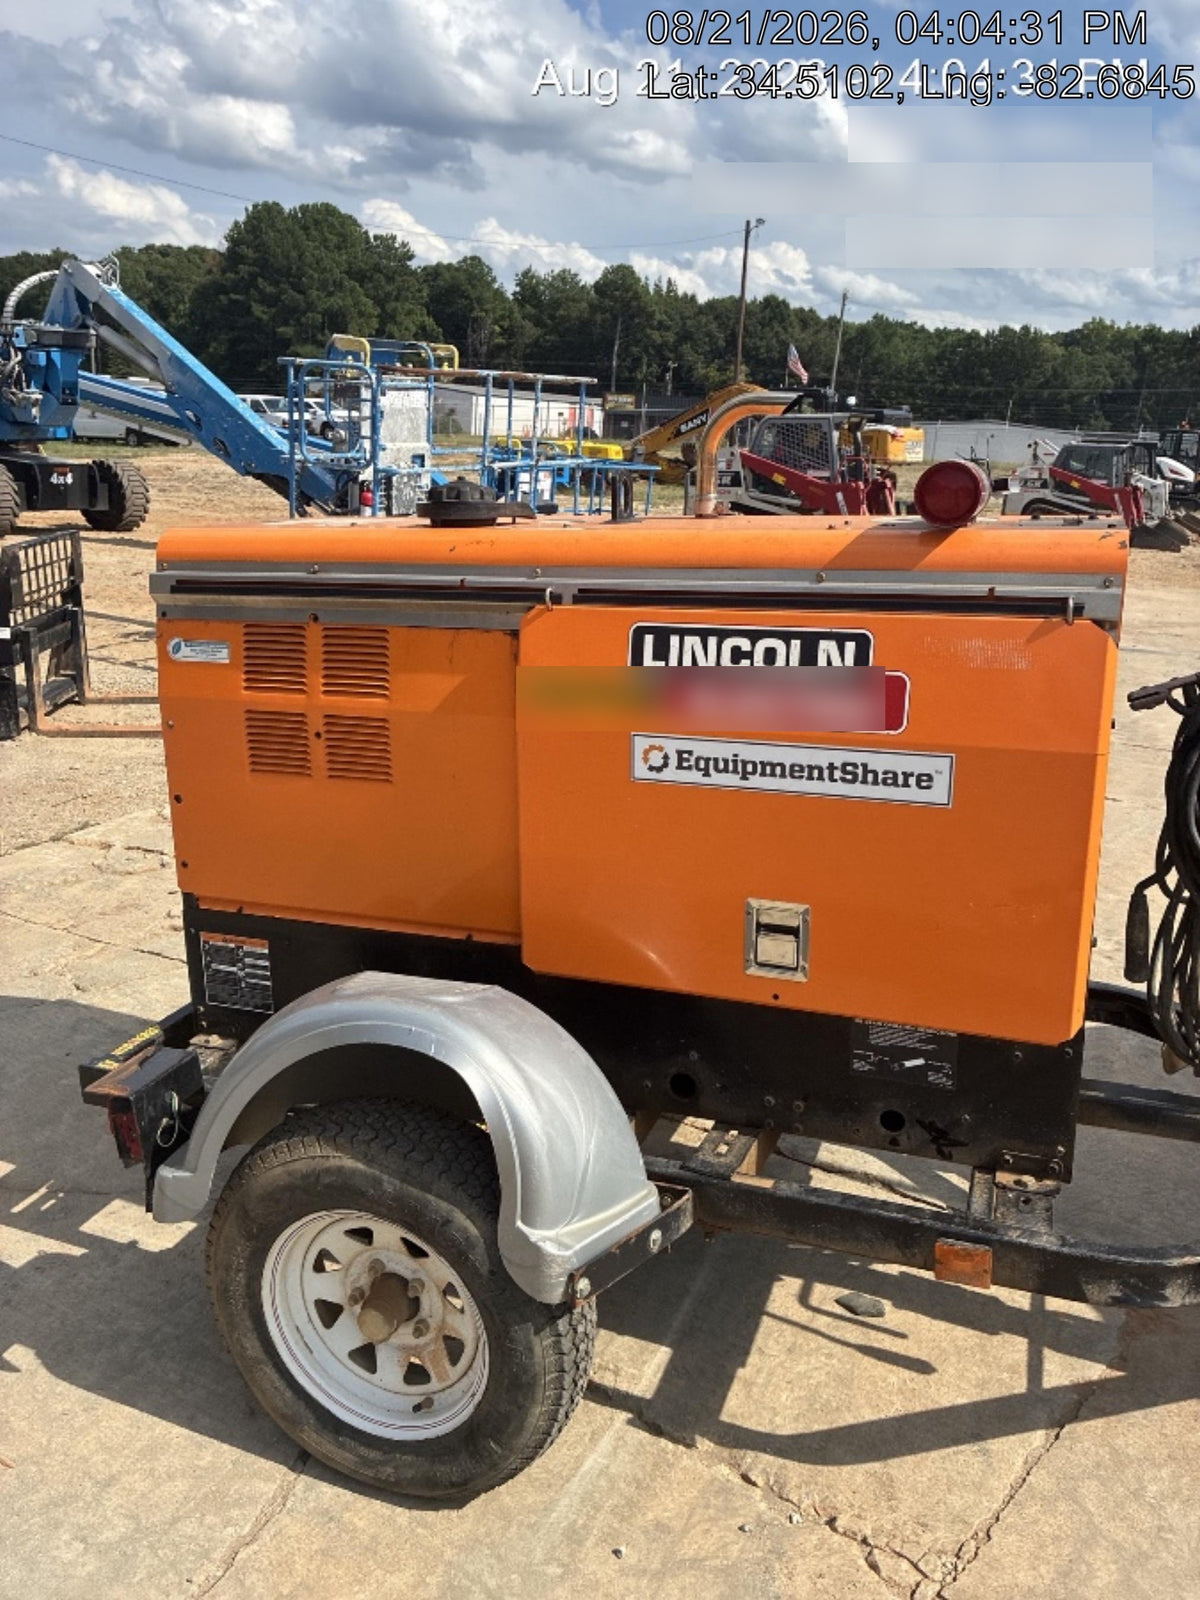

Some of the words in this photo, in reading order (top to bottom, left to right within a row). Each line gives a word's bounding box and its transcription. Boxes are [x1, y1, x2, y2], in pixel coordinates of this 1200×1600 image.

[50, 472, 73, 485] 4x4
[642, 633, 857, 668] LINCOLN
[674, 748, 935, 792] EquipmentShare
